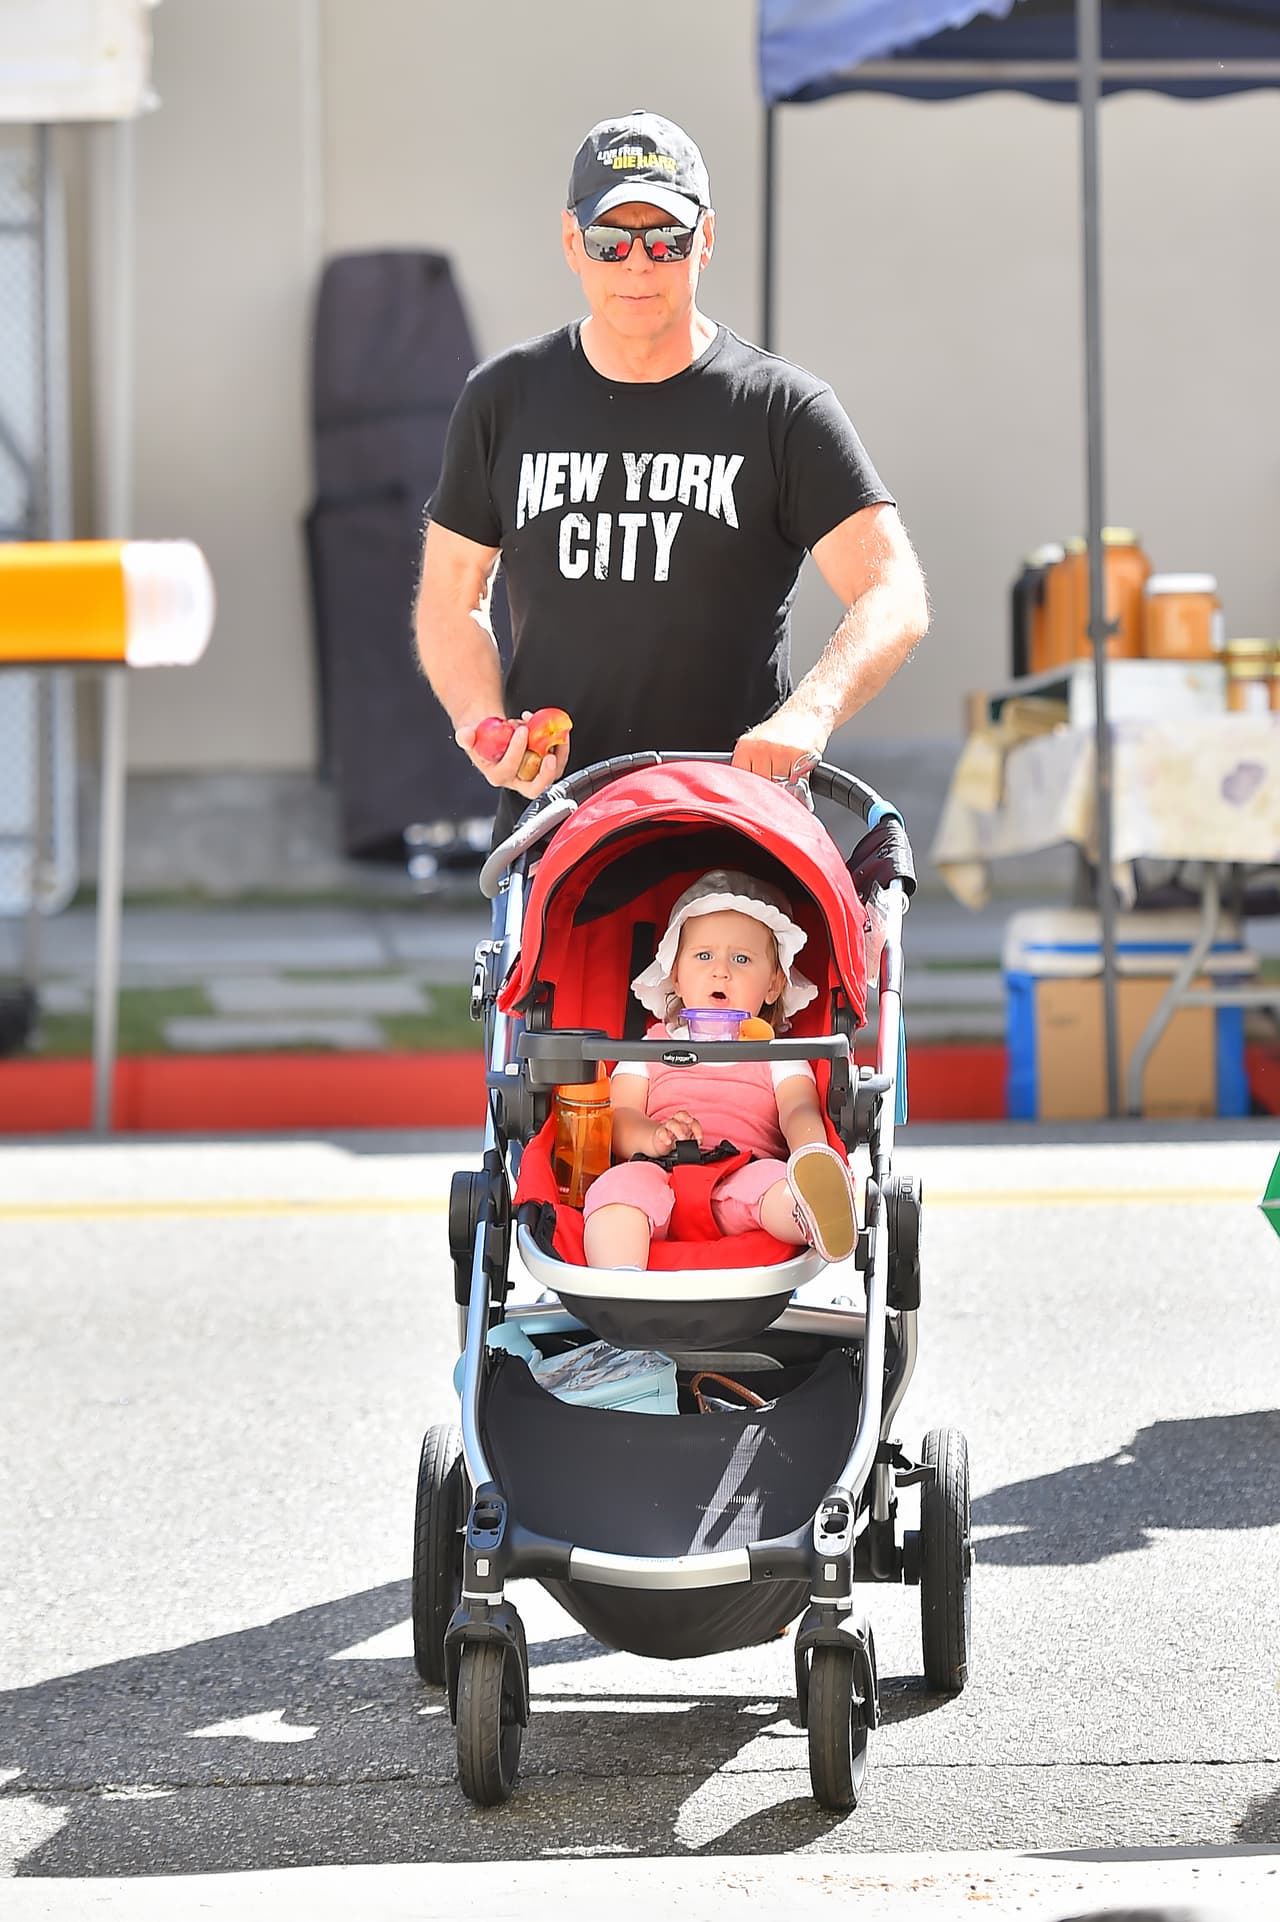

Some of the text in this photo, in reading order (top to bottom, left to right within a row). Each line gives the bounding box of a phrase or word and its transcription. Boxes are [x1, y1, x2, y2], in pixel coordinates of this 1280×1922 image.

[597, 145, 644, 161] LIVE FREE
[612, 156, 637, 170] DIE
[636, 152, 678, 173] HARD
[516, 452, 745, 530] NEW YORK
[558, 511, 684, 582] CITY
